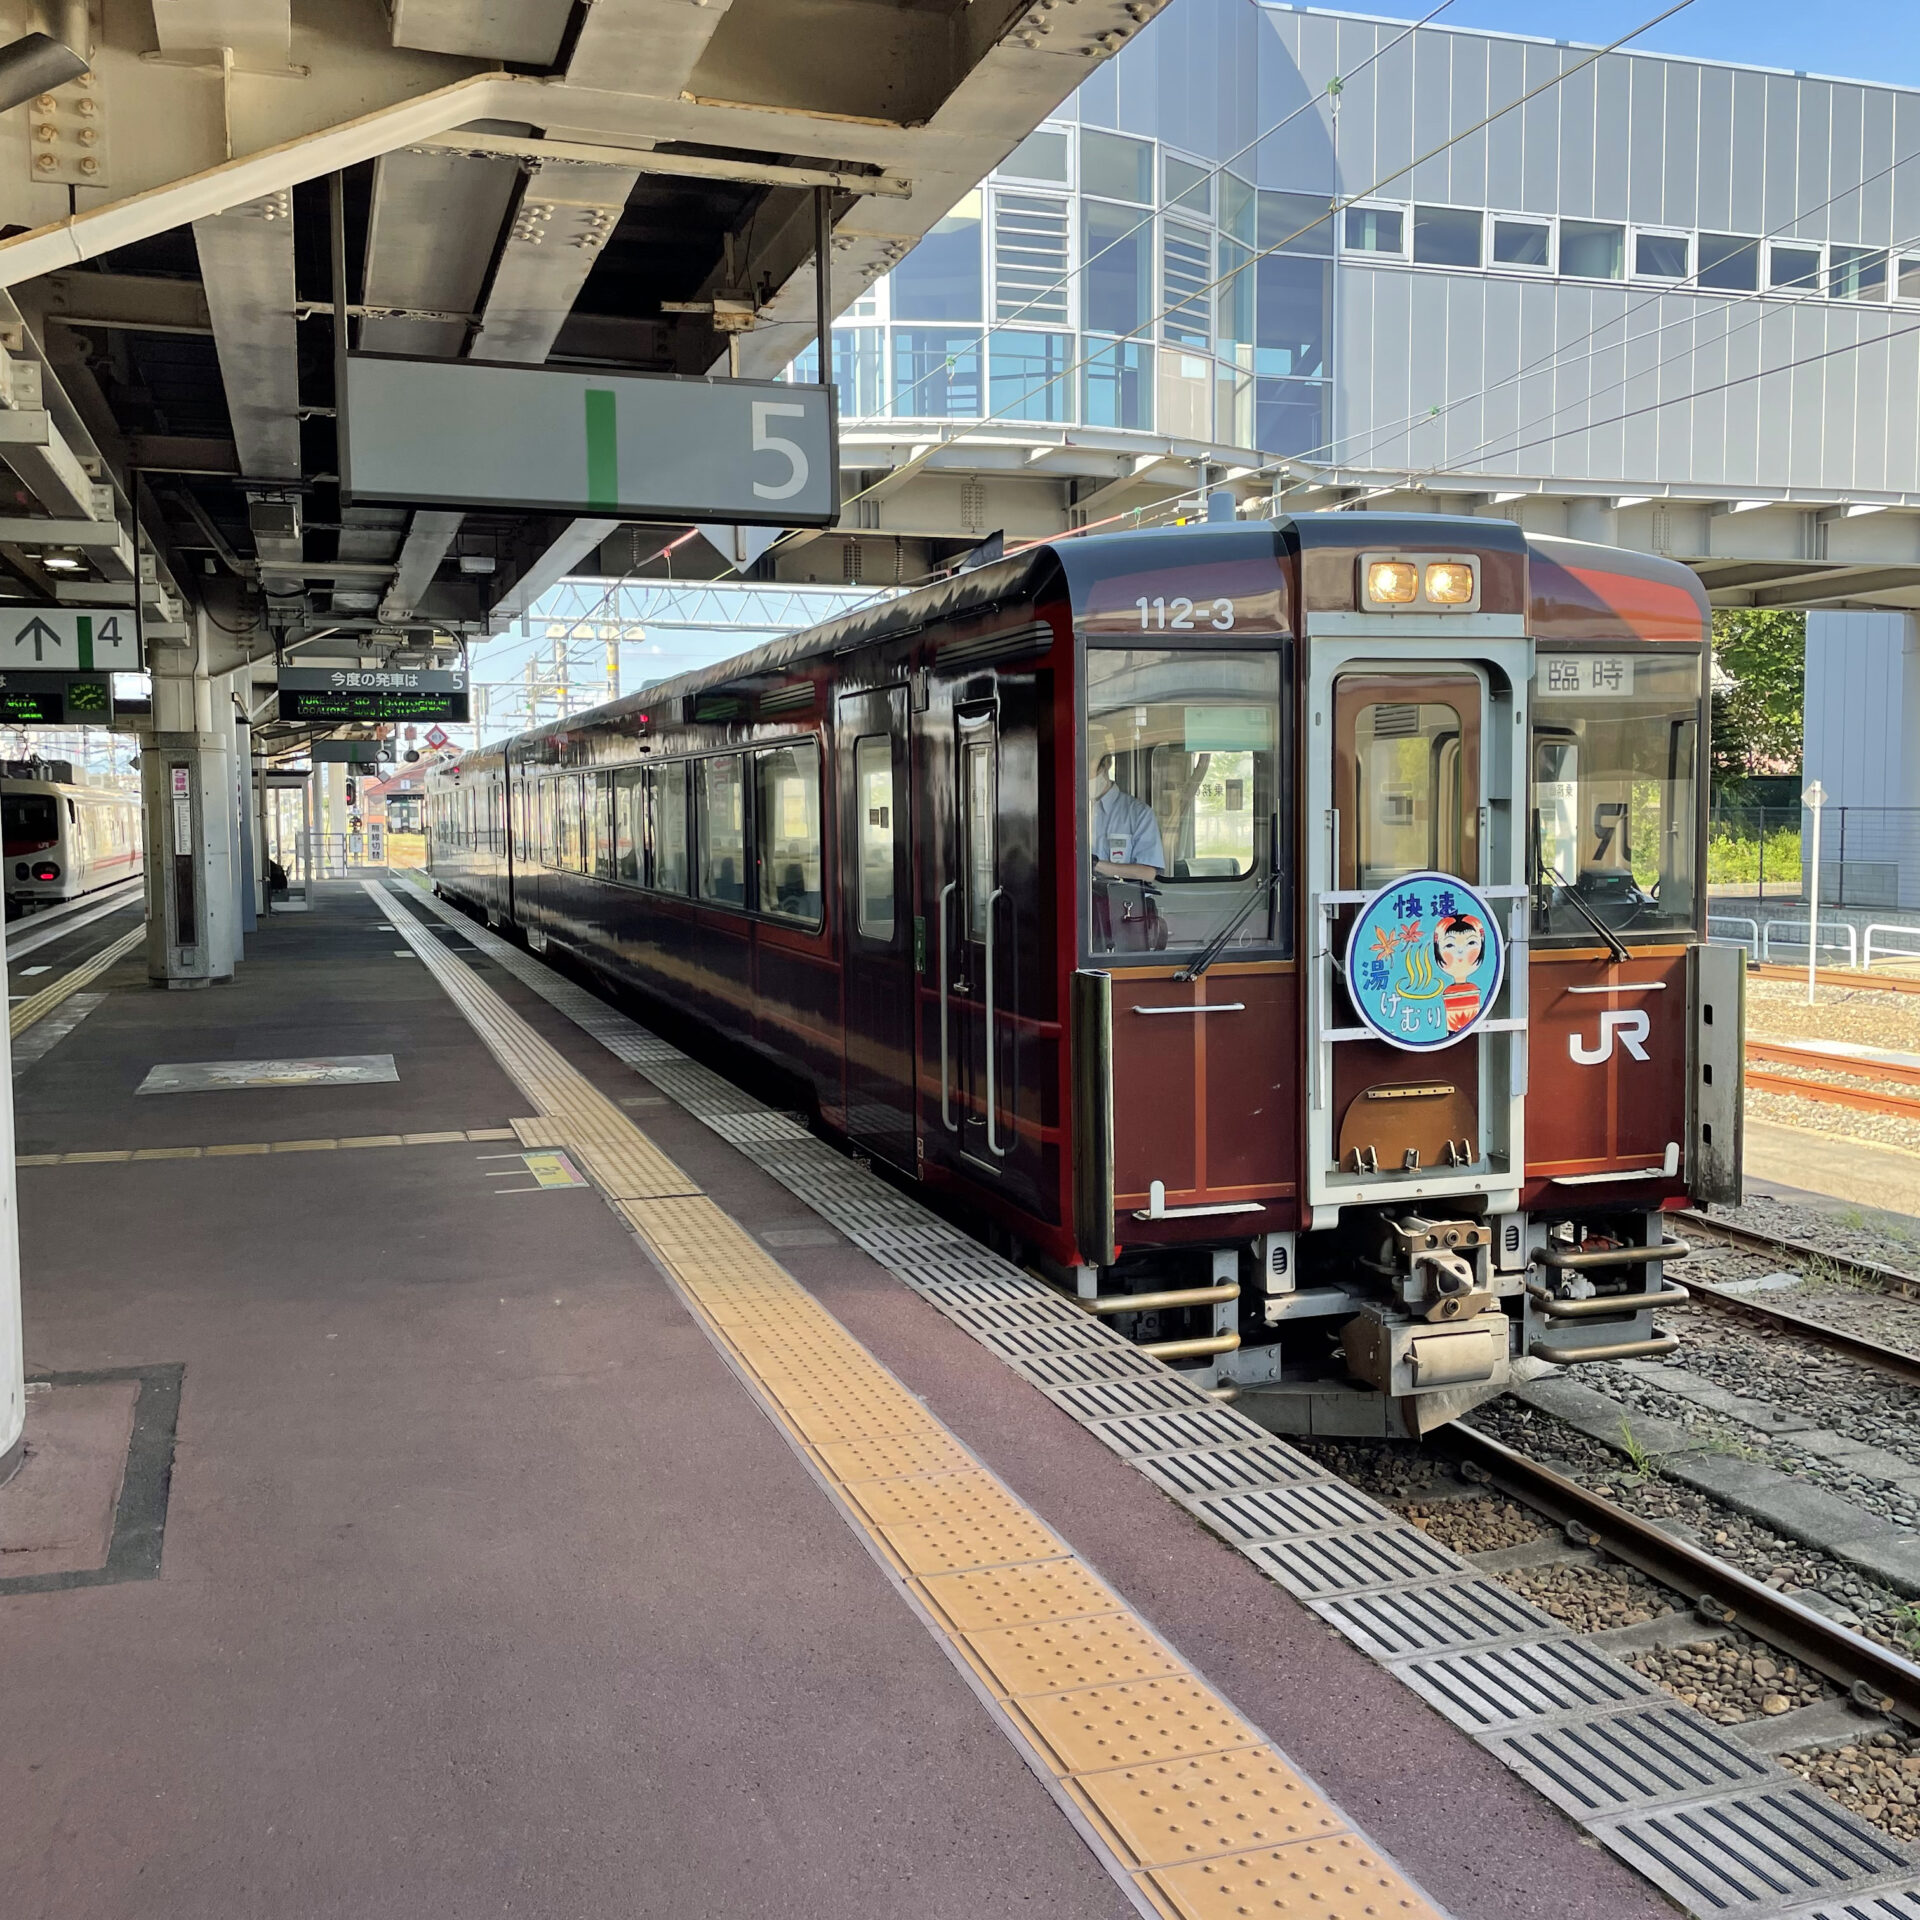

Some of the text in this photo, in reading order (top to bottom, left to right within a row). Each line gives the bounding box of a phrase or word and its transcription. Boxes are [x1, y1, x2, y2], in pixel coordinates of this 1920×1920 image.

[751, 401, 809, 500] 5
[1136, 596, 1235, 630] 112-3
[97, 616, 122, 647] 4
[331, 672, 464, 690] 今度の発車は 5
[1548, 659, 1624, 691] 臨時
[1393, 891, 1459, 918] 快速
[1570, 1010, 1650, 1065] JR
